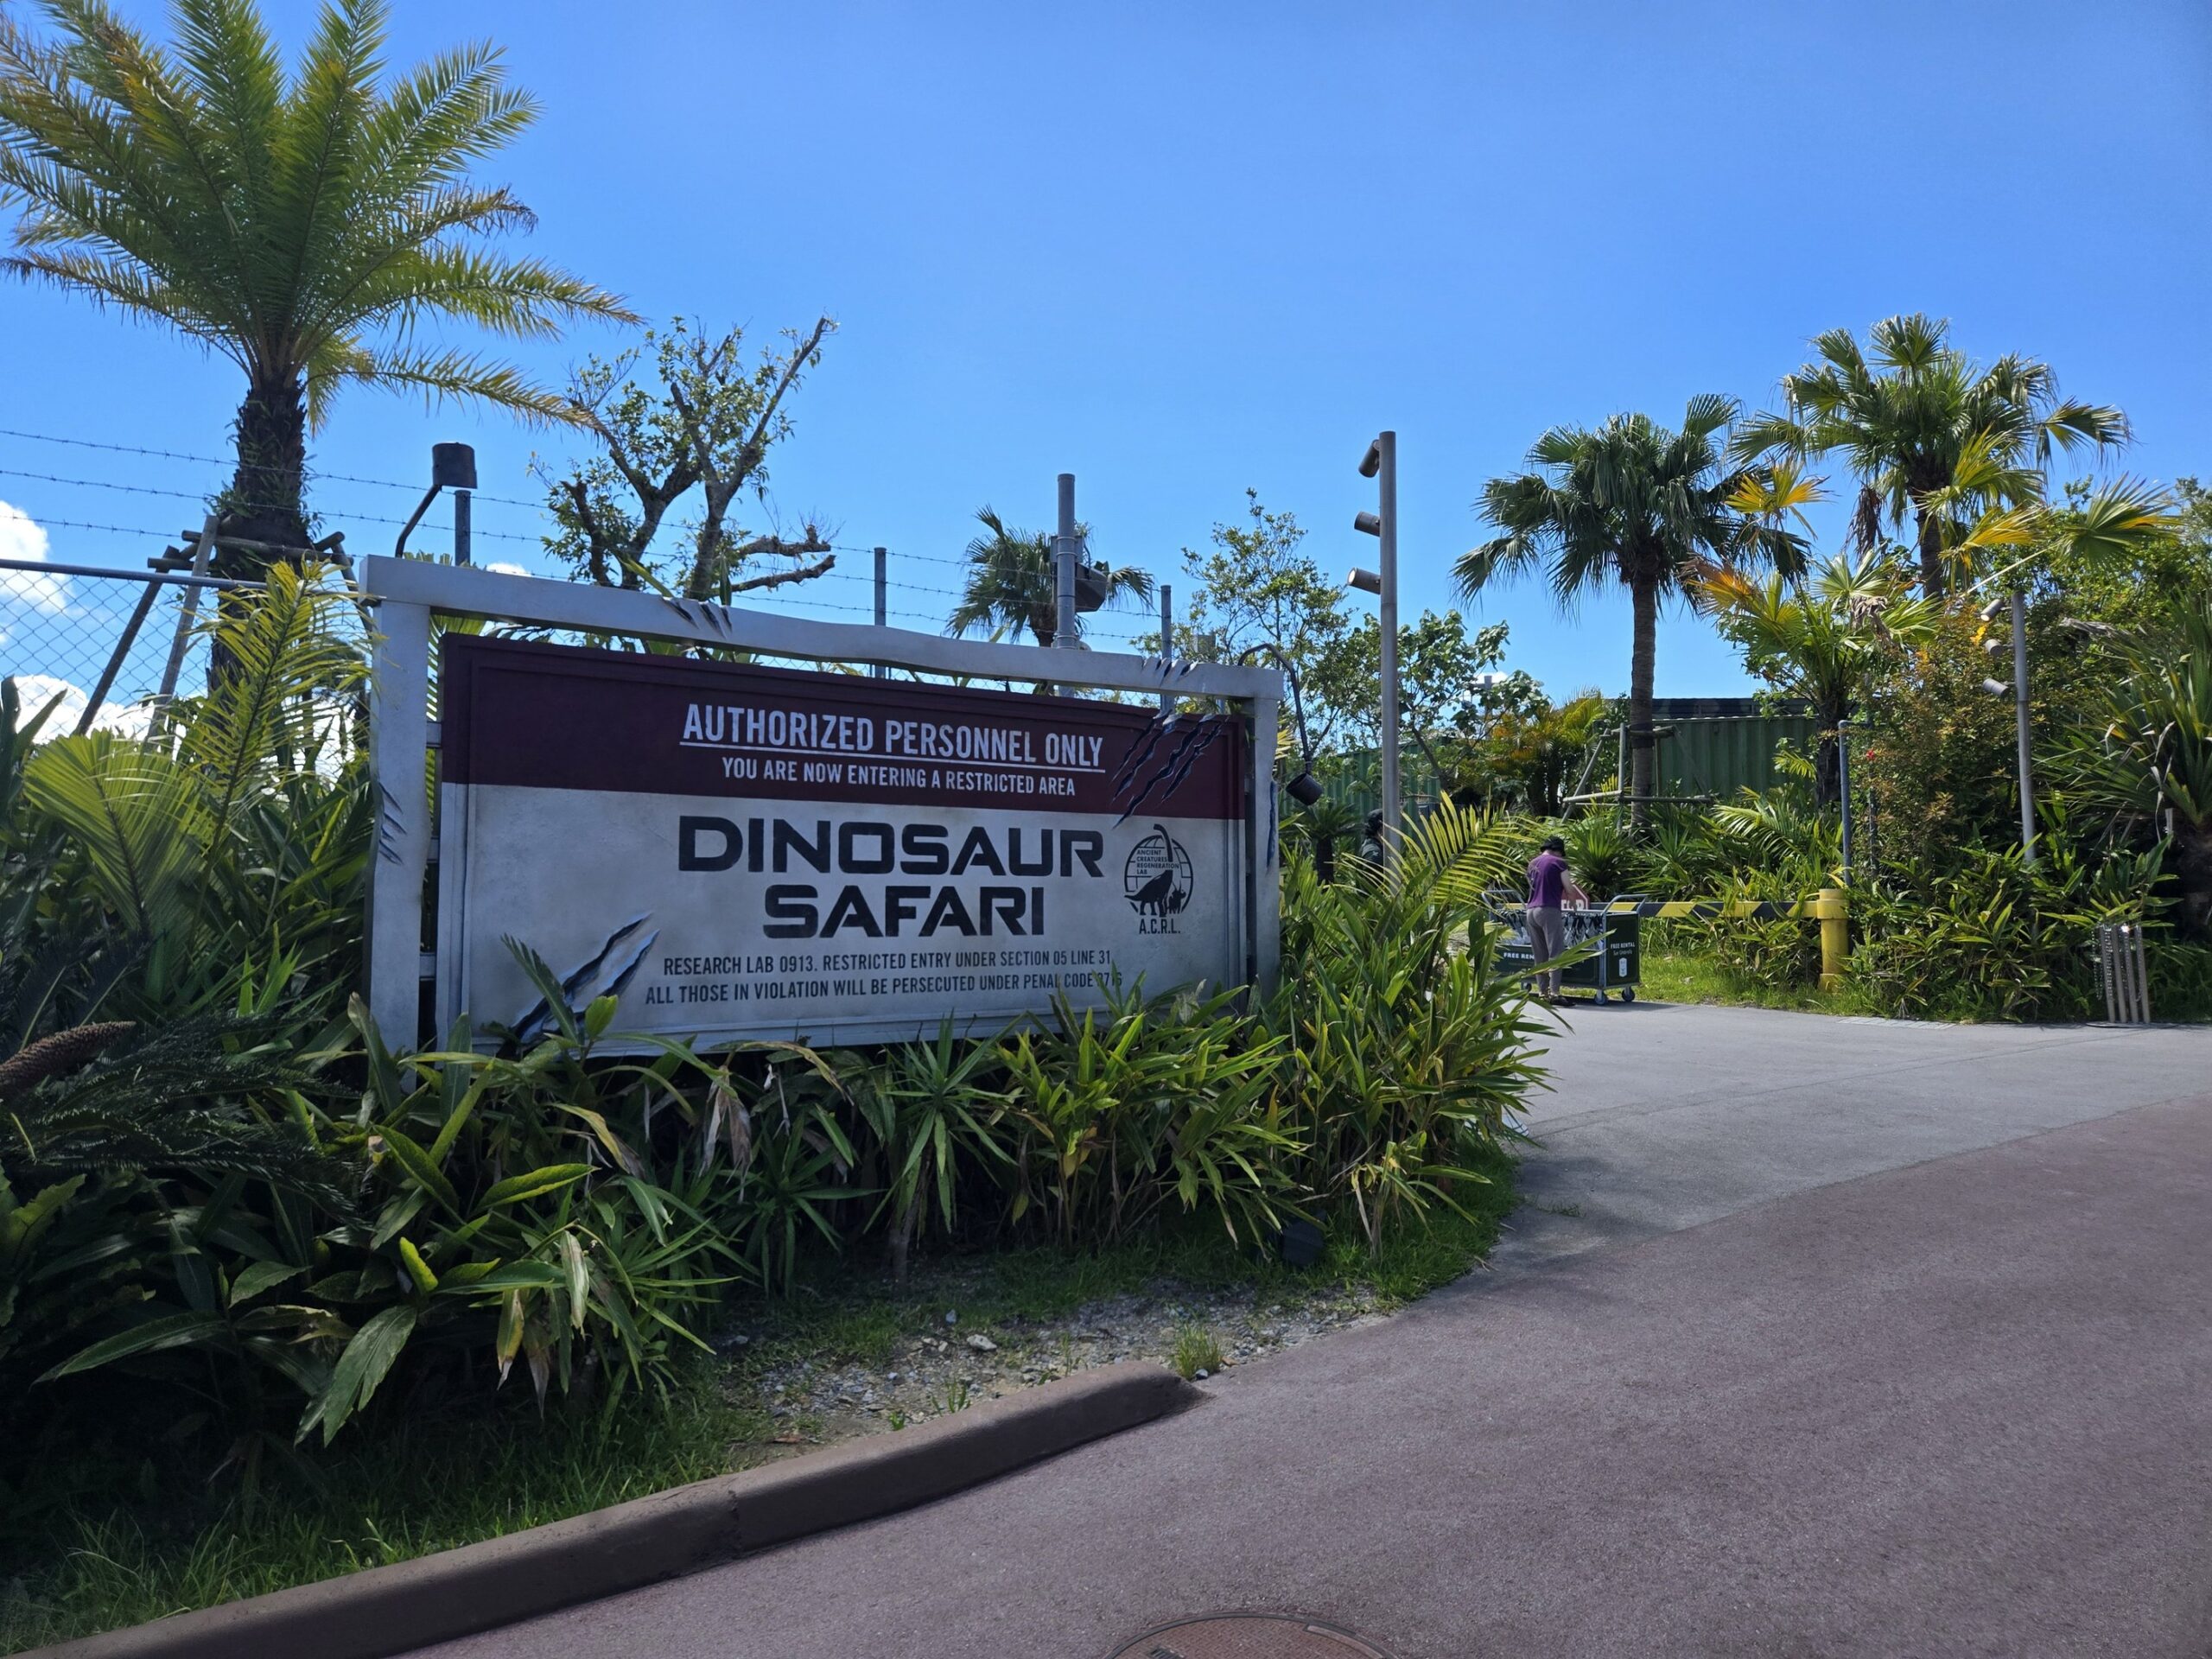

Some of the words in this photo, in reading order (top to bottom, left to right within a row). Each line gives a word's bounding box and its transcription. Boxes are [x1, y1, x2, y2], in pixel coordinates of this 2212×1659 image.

[683, 703, 874, 752] AUTHORIZED
[885, 720, 1037, 763] PERSONNEL
[1045, 733, 1103, 767] ONLY
[722, 757, 758, 779] YOU
[763, 760, 798, 782] ARE
[804, 762, 843, 784] NOW
[848, 765, 926, 788] ENTERING
[931, 771, 941, 789] A
[945, 771, 1034, 794] RESTRICTED
[1039, 777, 1076, 797] AREA
[678, 815, 1105, 878] DINOSAUR
[762, 884, 1045, 939] SAFARI
[1139, 918, 1181, 934] A.C.R.L.
[664, 957, 741, 976] RESEARCH
[747, 956, 774, 974] LAB
[779, 955, 818, 973] 0913.
[823, 953, 906, 971] RESTRICTED
[911, 953, 951, 969] ENTRY
[956, 951, 996, 968] UNDER
[1001, 950, 1050, 967] SECTION
[1053, 950, 1068, 966] 05
[1071, 950, 1096, 965] LINE
[1098, 950, 1110, 965] 31
[645, 986, 674, 1005] ALL
[678, 983, 728, 1003] THOSE
[734, 982, 749, 1001] IN
[753, 980, 830, 1001] VIOLATION
[833, 978, 867, 996] WILL
[870, 977, 887, 995] BE
[893, 976, 976, 994] PERSECUTED
[979, 974, 1020, 991] UNDER
[1023, 973, 1059, 989] PENAL
[1064, 973, 1094, 988] CODE
